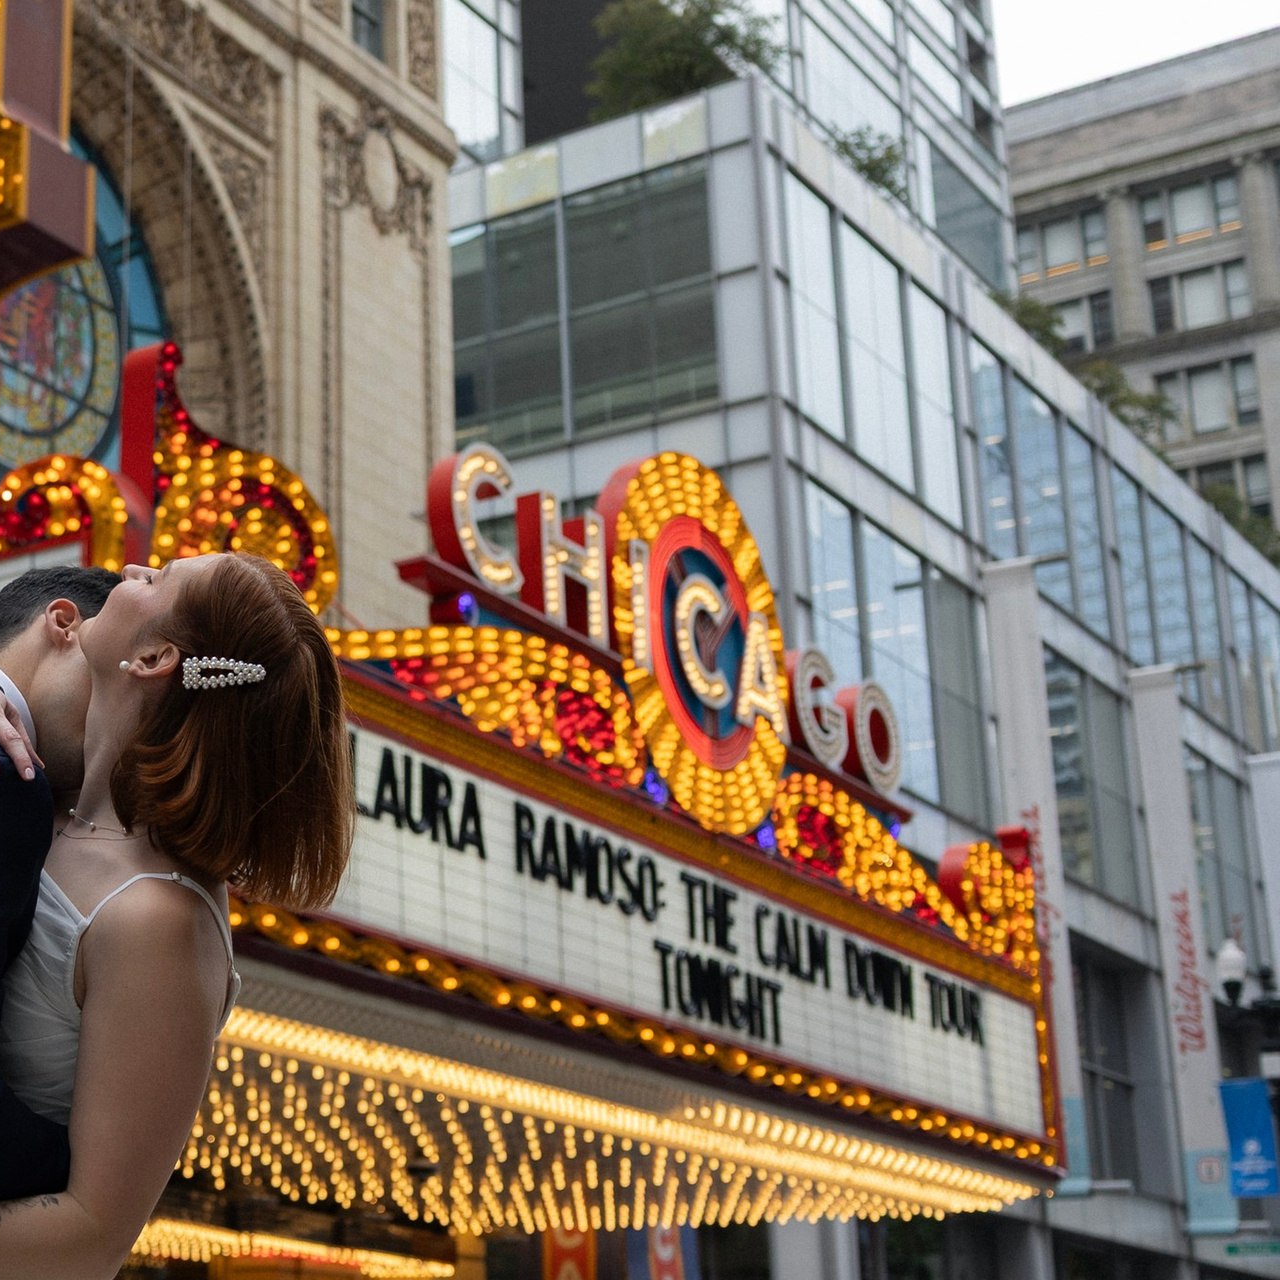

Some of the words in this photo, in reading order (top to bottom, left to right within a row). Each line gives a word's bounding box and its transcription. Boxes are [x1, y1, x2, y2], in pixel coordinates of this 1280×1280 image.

[452, 442, 902, 797] CHICAGO
[654, 939, 783, 1046] TONIGHT
[680, 870, 738, 955] THE
[755, 901, 831, 990] CALM
[843, 937, 916, 1021] DOWN
[924, 972, 985, 1048] TOUR
